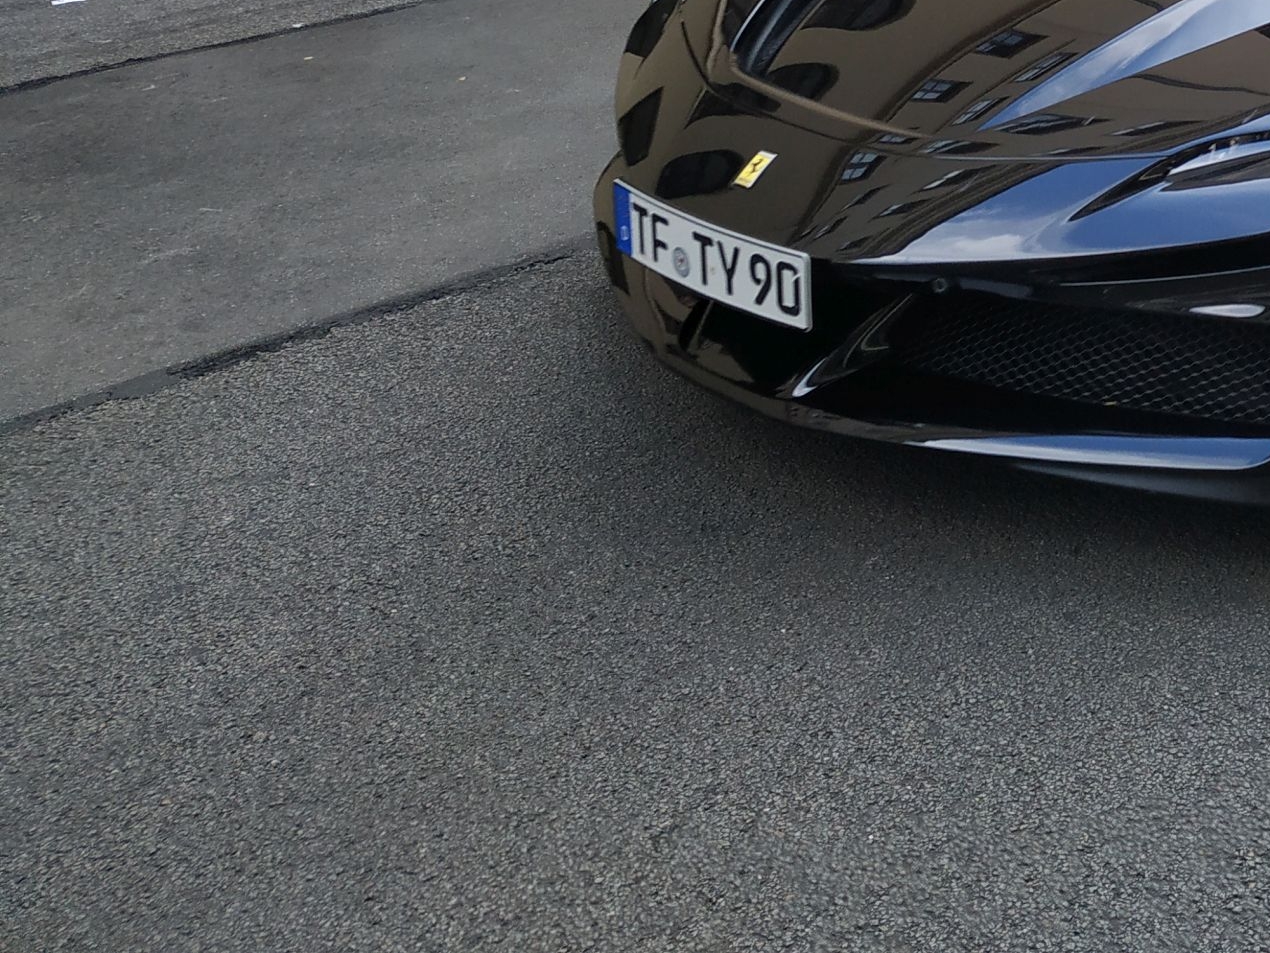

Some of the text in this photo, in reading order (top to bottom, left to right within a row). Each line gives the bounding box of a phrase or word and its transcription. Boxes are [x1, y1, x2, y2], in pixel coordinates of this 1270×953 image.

[631, 202, 801, 317] TF TY 90
